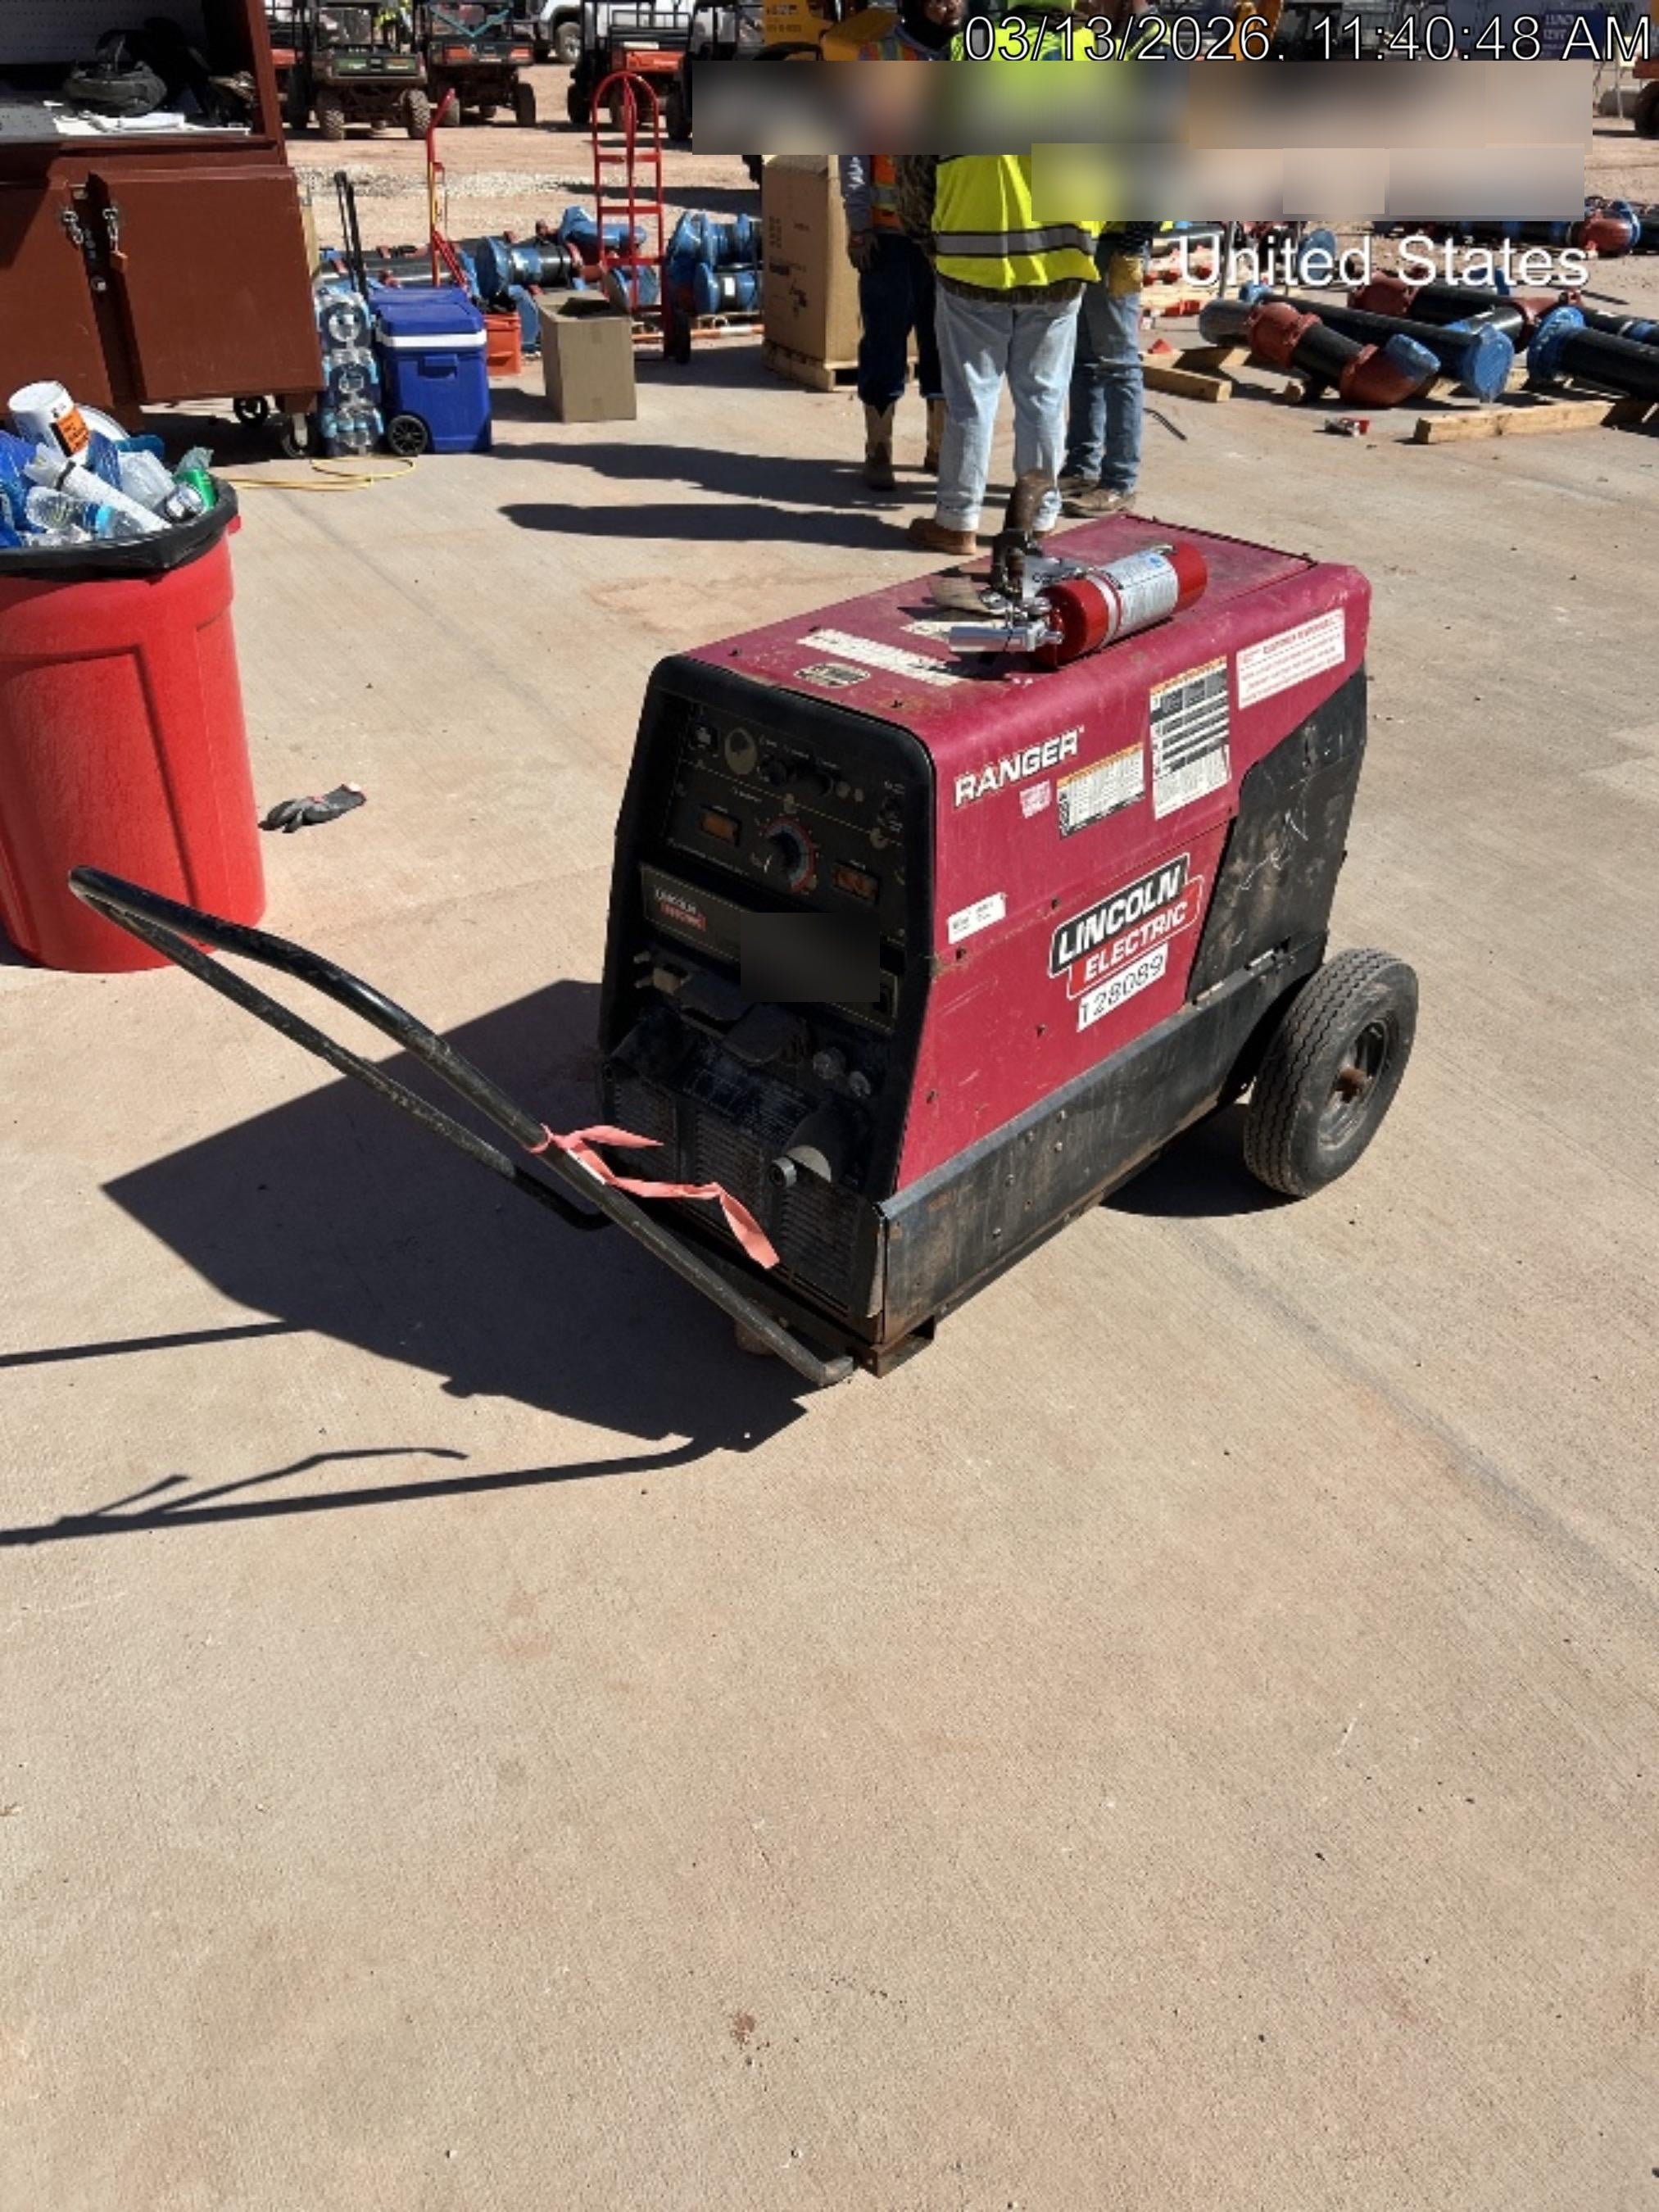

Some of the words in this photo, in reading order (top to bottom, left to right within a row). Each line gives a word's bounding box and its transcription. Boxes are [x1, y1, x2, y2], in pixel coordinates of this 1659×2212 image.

[954, 728, 1079, 808] RANGER
[1058, 863, 1181, 965] LINCOLN
[1084, 900, 1188, 983] ELECTRIC
[1081, 954, 1164, 1023] 128089
